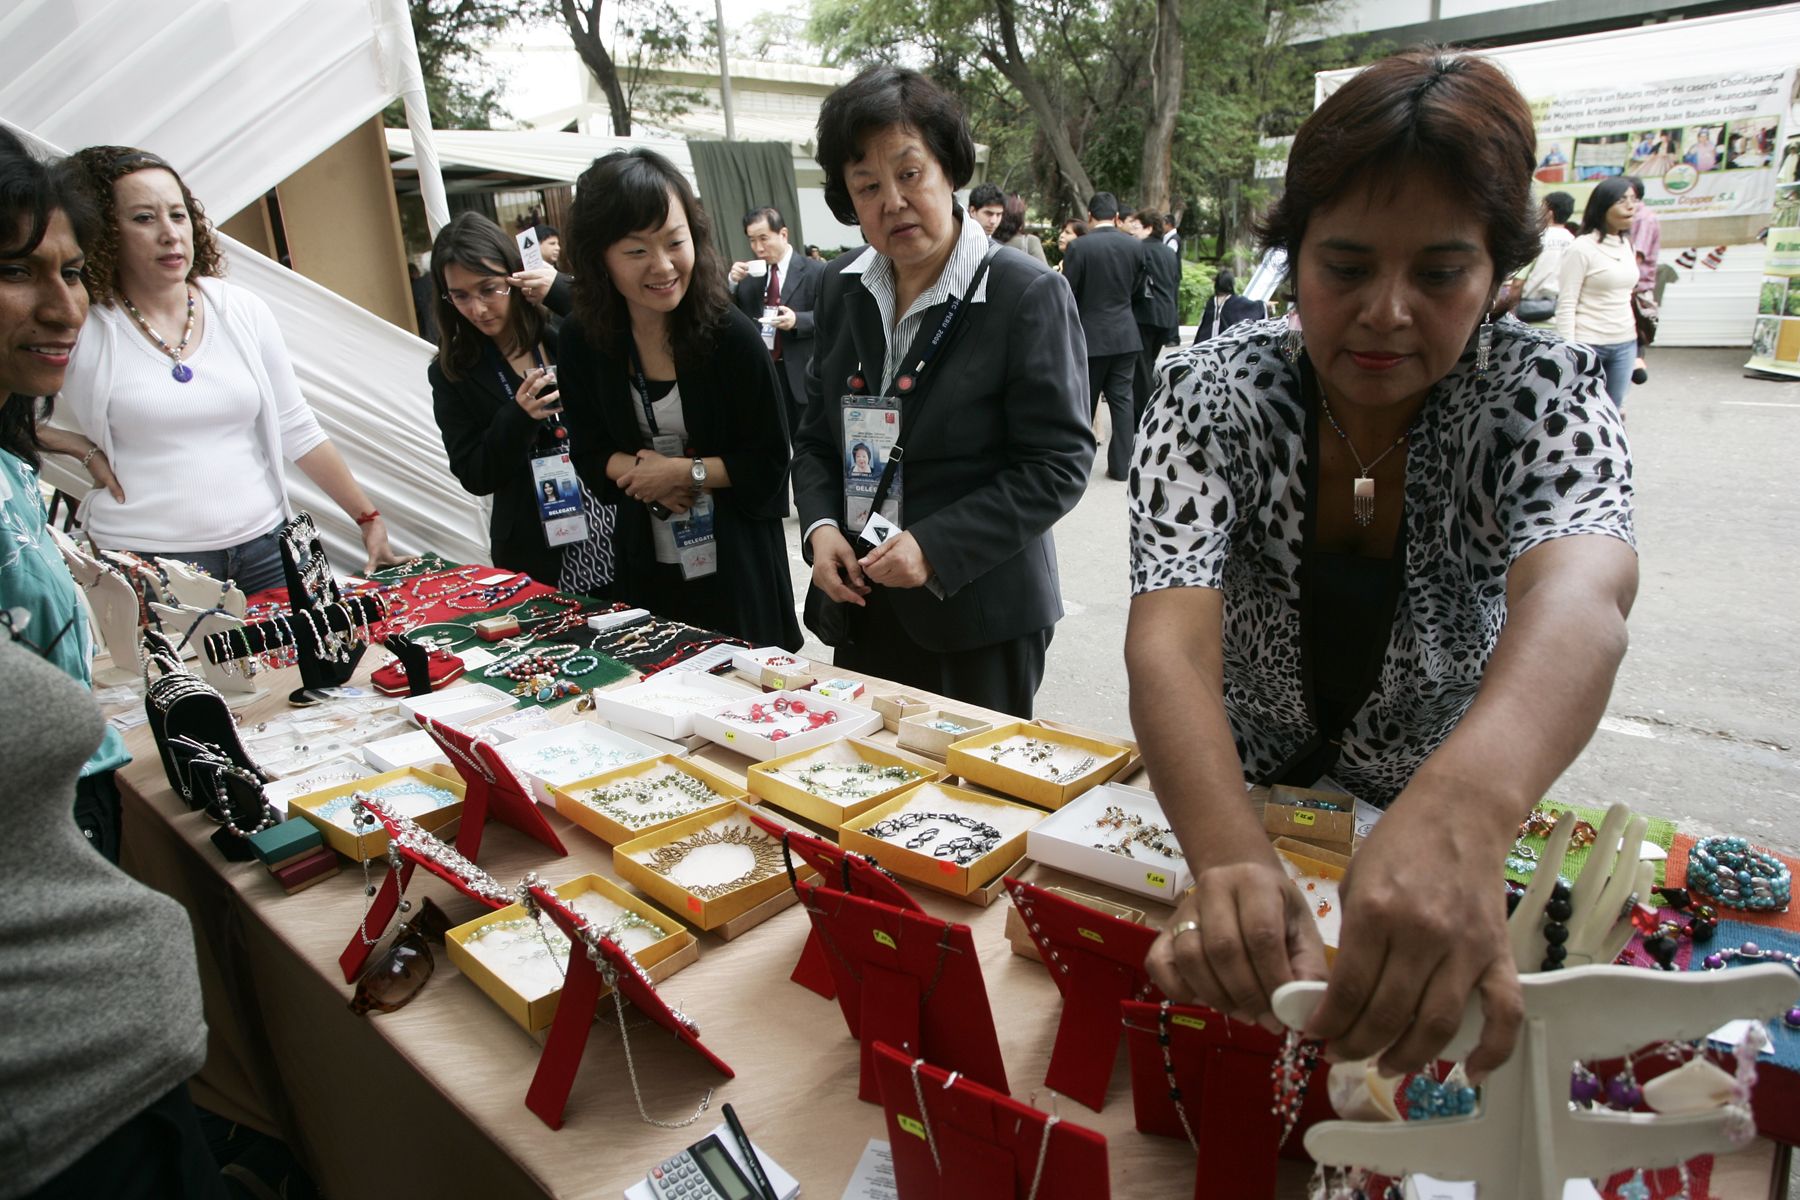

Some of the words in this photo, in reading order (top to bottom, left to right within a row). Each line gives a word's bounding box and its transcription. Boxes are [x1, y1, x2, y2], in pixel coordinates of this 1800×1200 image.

[1552, 98, 1582, 108] Mujeres
[1585, 96, 1602, 106] para
[1617, 90, 1641, 99] futuro
[1645, 87, 1669, 97] mejor
[1554, 109, 1584, 121] Mujeres
[1628, 101, 1655, 113] Virgen
[1656, 99, 1669, 108] del
[1672, 95, 1705, 107] Carmen
[1565, 121, 1596, 132] Mujeres
[1598, 114, 1660, 127] Emprendedoras
[1663, 112, 1682, 121] Juan
[1685, 106, 1720, 118] Bautista
[942, 311, 953, 328] PERU
[932, 329, 943, 345] 2008
[549, 506, 577, 516] DELEGATE
[684, 534, 713, 546] DELEGATE
